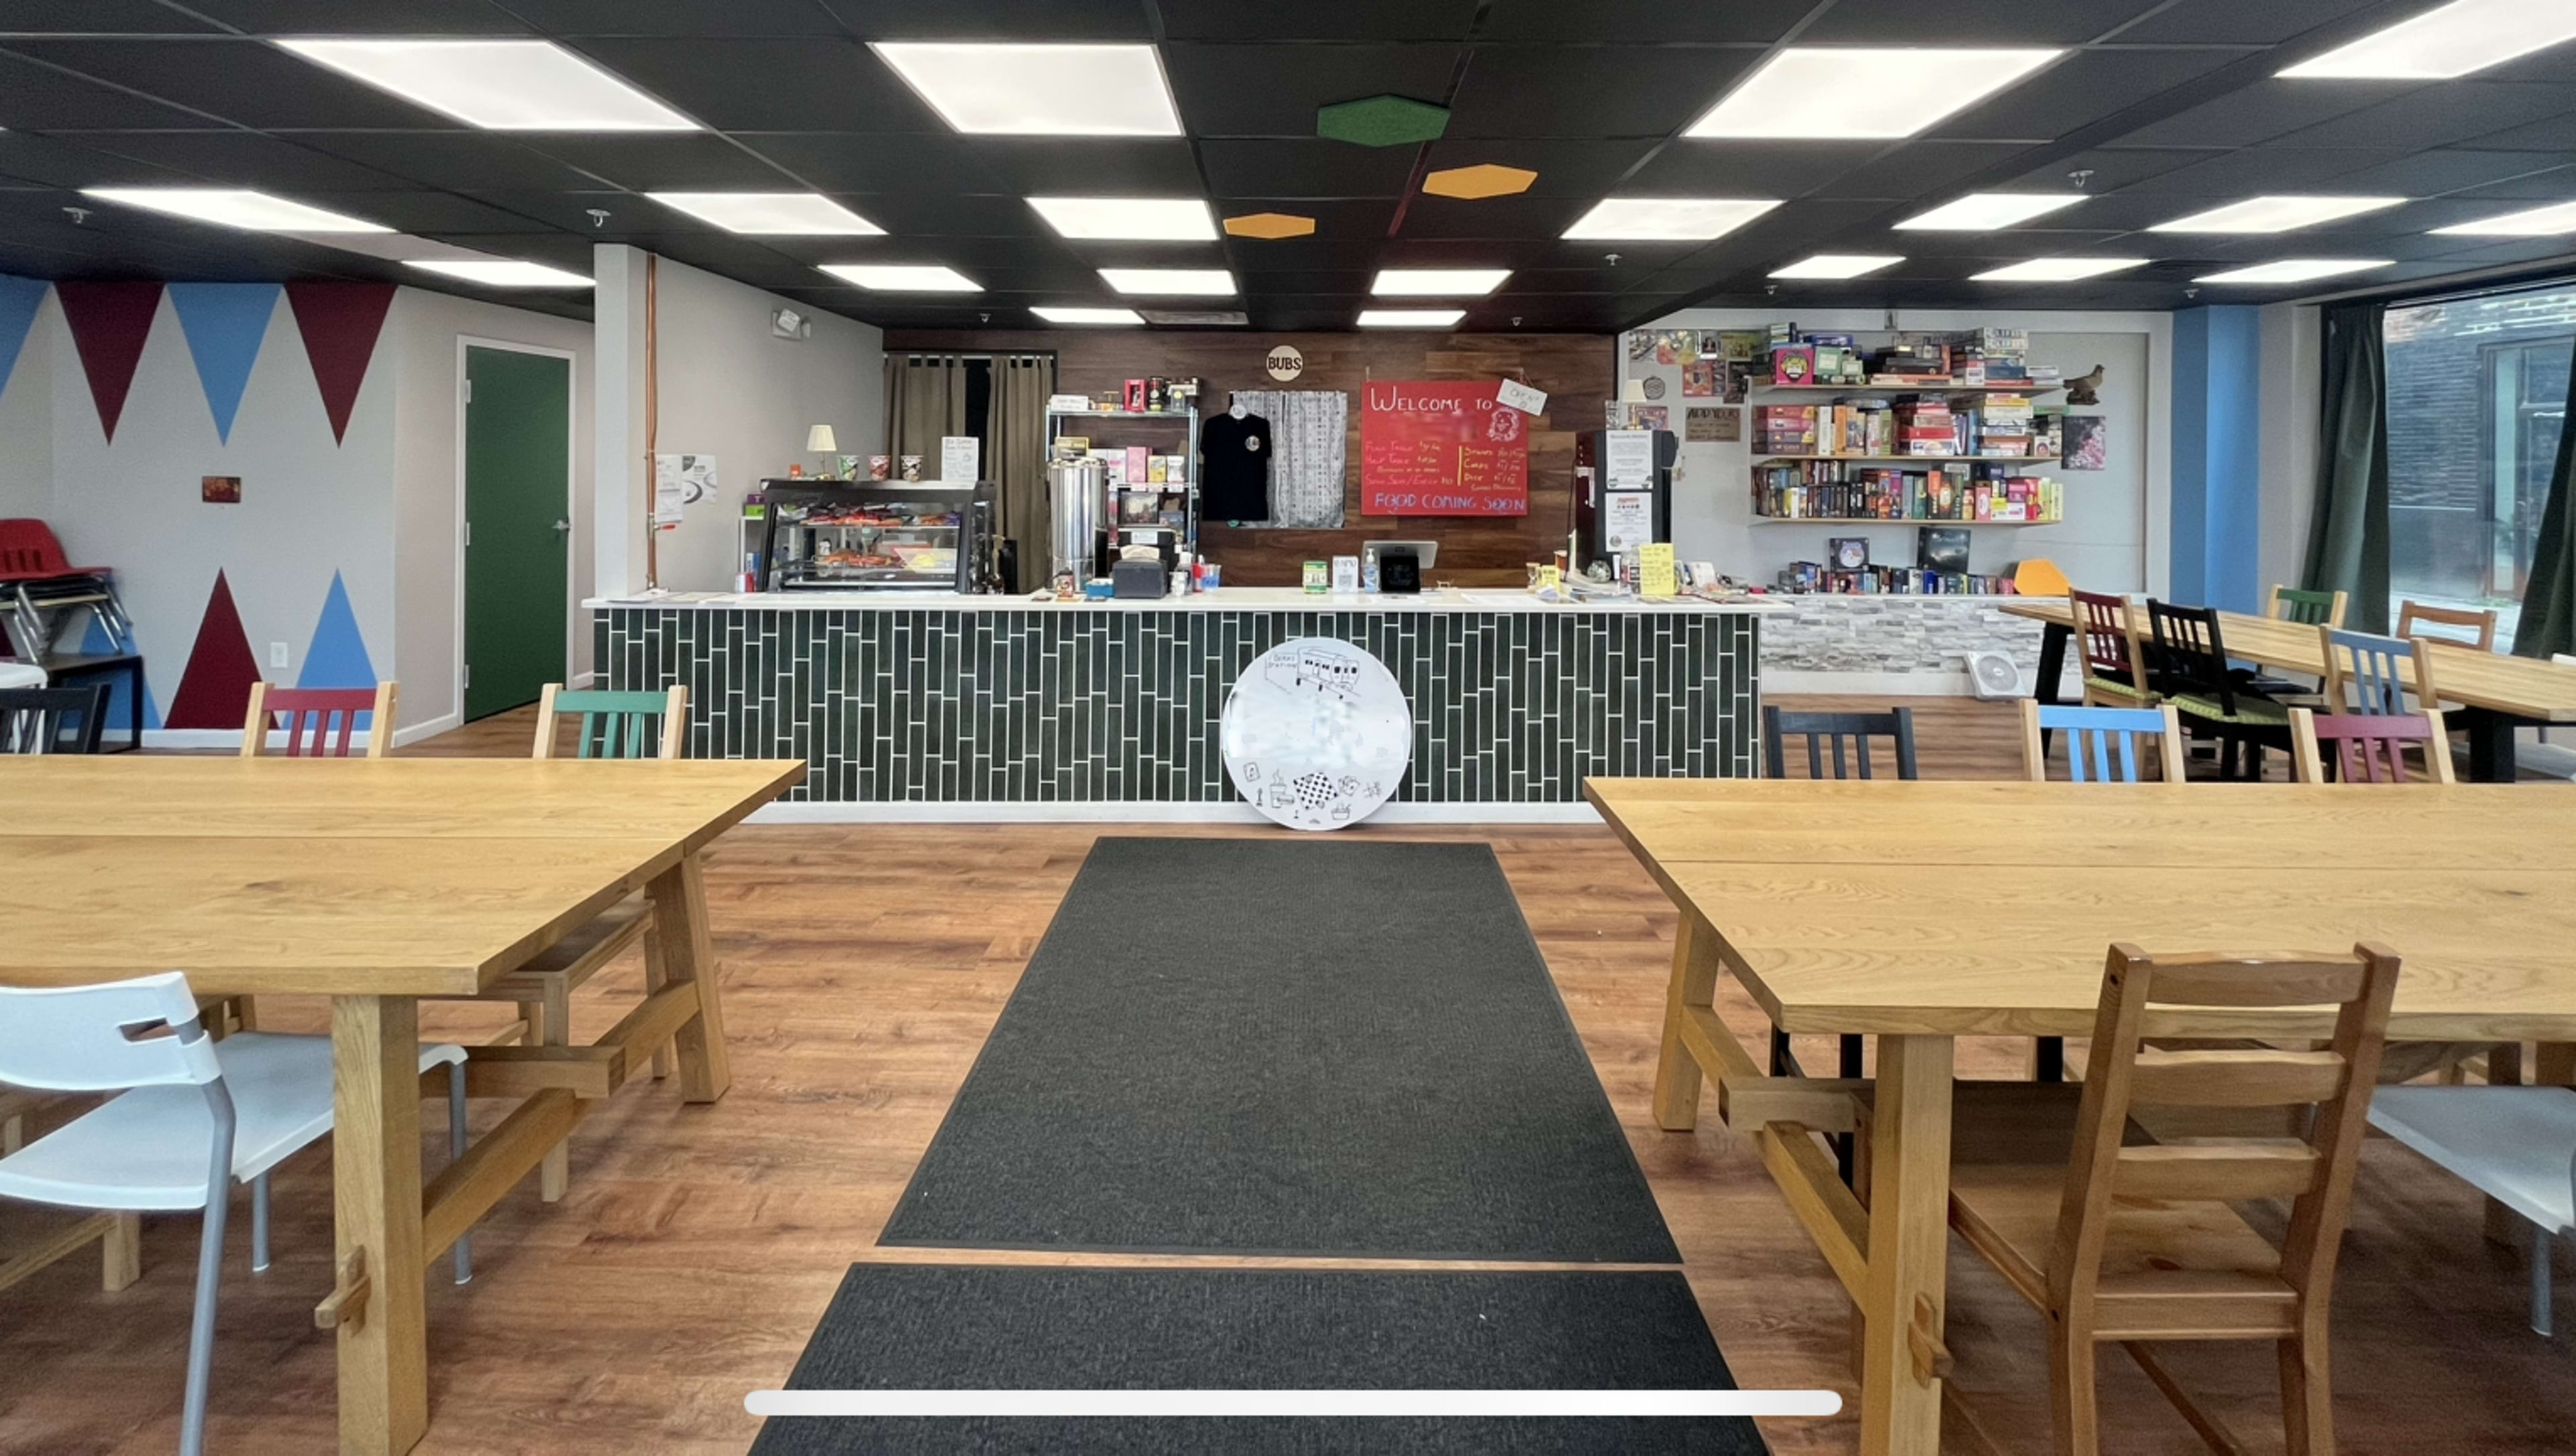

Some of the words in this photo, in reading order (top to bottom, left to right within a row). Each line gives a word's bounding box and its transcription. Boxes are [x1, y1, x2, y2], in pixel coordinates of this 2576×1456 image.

[1268, 357, 1301, 370] BUBS
[1371, 385, 1462, 411] WELCOME
[1476, 399, 1493, 411] TO
[1375, 492, 1417, 508] FOOD
[1421, 493, 1477, 509] COMING
[1481, 495, 1526, 511] SOON
